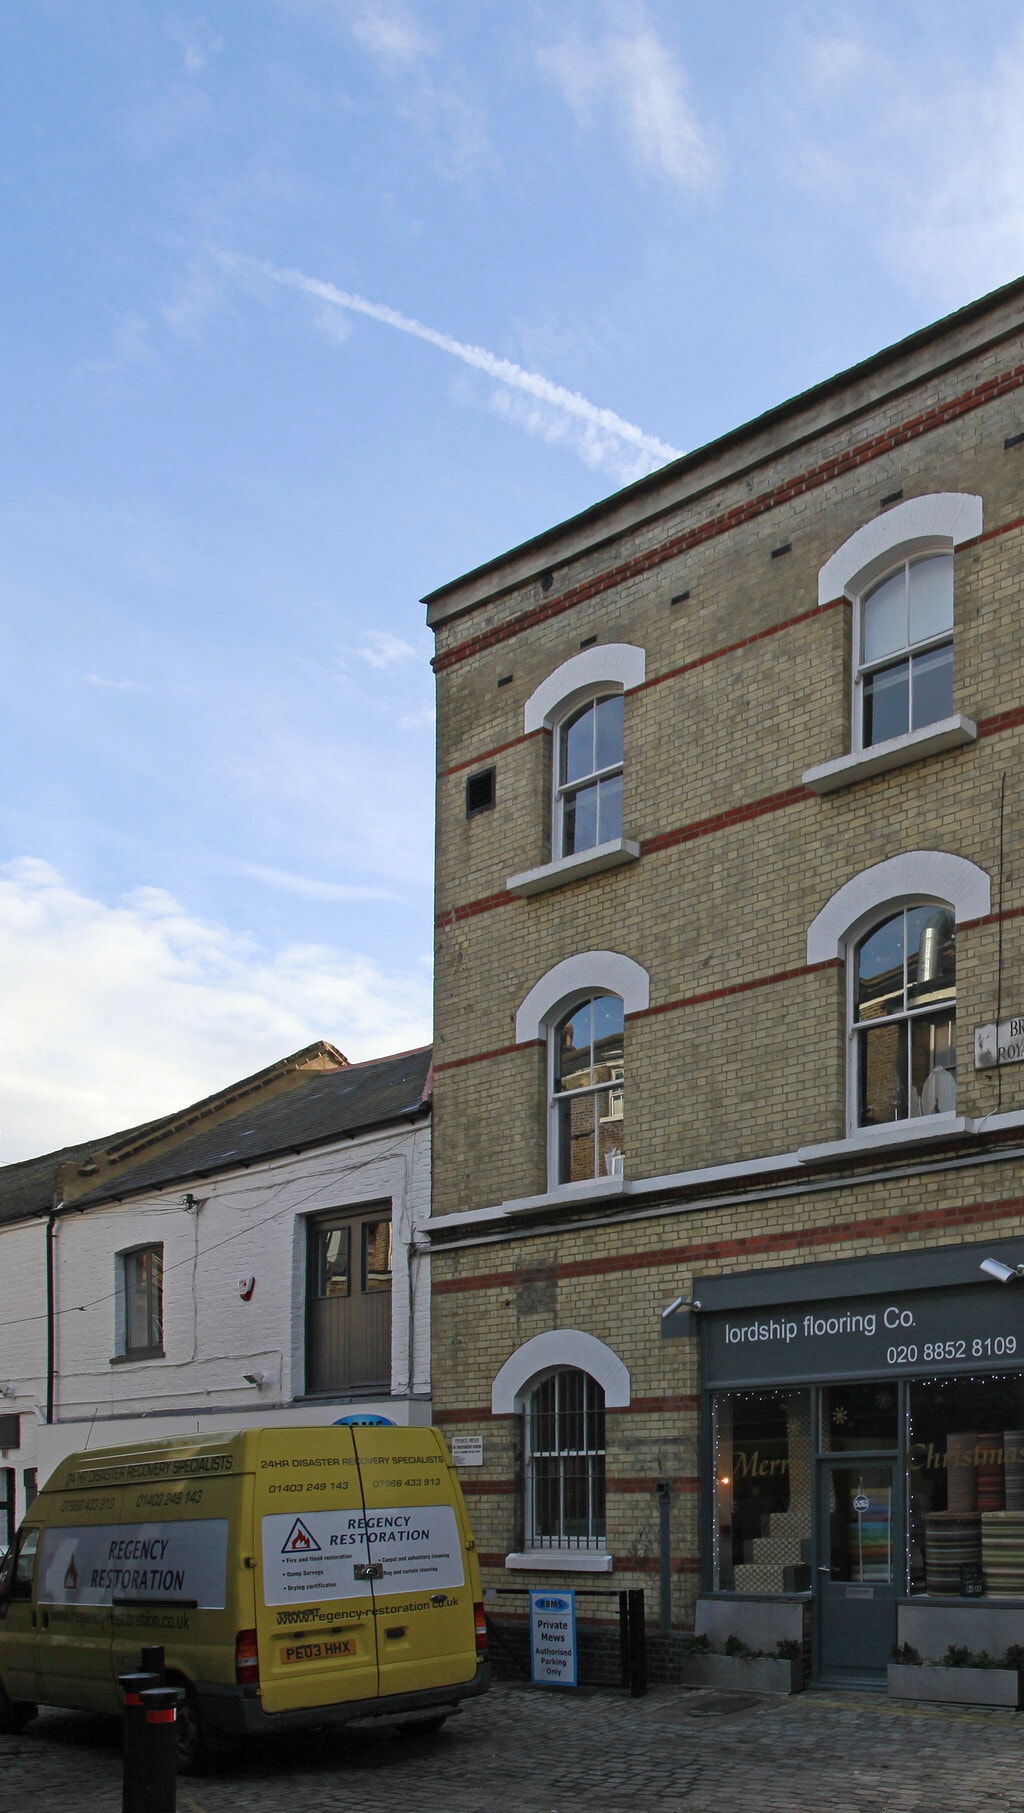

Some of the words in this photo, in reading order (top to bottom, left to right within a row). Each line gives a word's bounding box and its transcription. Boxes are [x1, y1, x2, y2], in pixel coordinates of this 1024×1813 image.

[725, 1319, 797, 1343] lordship
[803, 1312, 876, 1336] flooring
[883, 1307, 916, 1329] Co.
[886, 1345, 918, 1364] 020
[923, 1340, 966, 1361] 8852
[971, 1335, 1017, 1357] 8109
[126, 1462, 171, 1477] RECOVERY
[172, 1455, 233, 1474] SPECIALISTS
[261, 1459, 290, 1468] 24HR
[292, 1458, 340, 1467] DISASTER
[342, 1457, 389, 1466] RECOVERY
[392, 1455, 444, 1464] SPECIALISTS
[268, 1483, 304, 1494] 01403
[306, 1482, 327, 1492] 249
[331, 1481, 349, 1490] 143
[404, 1478, 422, 1487] 433
[424, 1477, 441, 1486] 913
[185, 1490, 203, 1504] 143
[347, 1516, 411, 1530] REGENCY
[329, 1529, 430, 1546] RESTORATION
[108, 1539, 170, 1561] REGENCY
[91, 1569, 185, 1591] RESTORATION
[286, 1570, 301, 1578] Damp
[302, 1569, 324, 1577] Surveys
[541, 1600, 562, 1608] RBMS
[537, 1620, 568, 1630] Private
[541, 1633, 565, 1642] Mews
[286, 1645, 321, 1660] PE03
[325, 1641, 351, 1655] HHX
[535, 1647, 572, 1656] Authorised
[541, 1657, 567, 1667] Parking
[546, 1668, 562, 1676] Only
